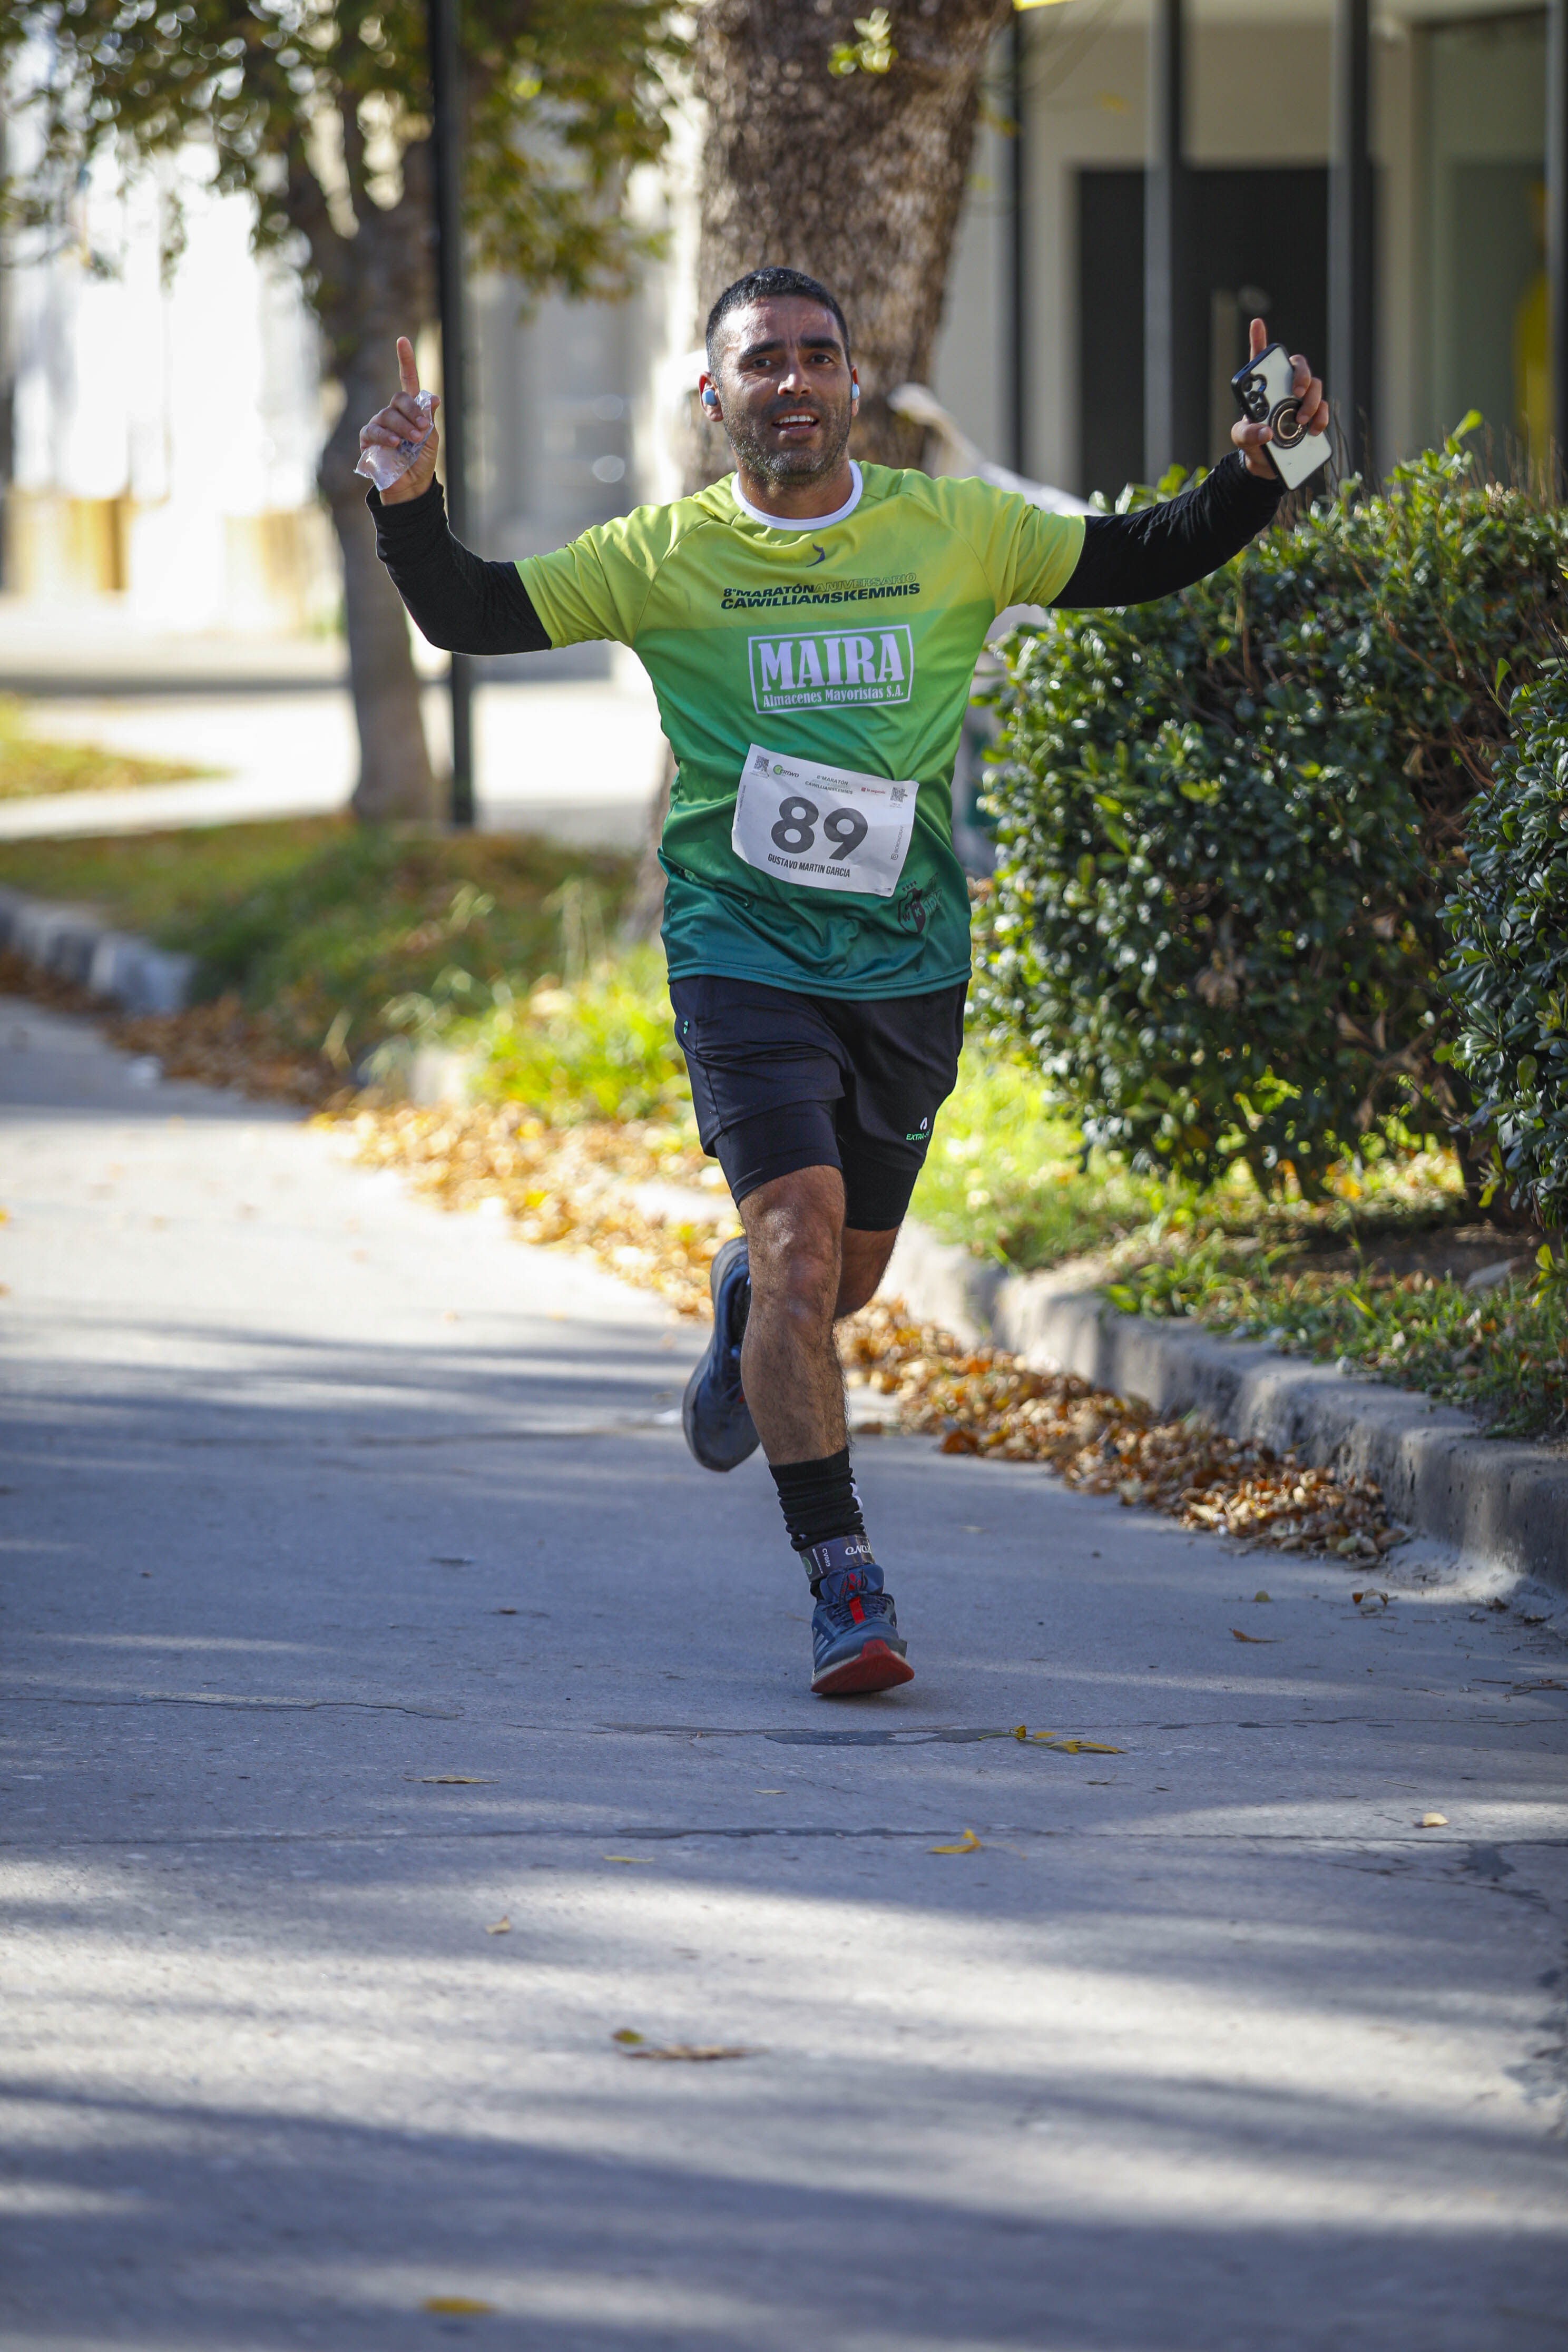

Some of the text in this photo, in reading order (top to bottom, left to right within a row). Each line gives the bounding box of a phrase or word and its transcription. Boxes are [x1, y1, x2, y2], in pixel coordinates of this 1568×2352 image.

[814, 572, 917, 593] ANIVERSARIO
[721, 583, 920, 610] CAWILLIAMSKEMMIS
[758, 633, 905, 692] MAIRA
[763, 684, 904, 708] Almacenes Mayoristas S.A.
[771, 796, 868, 861] 89
[768, 853, 850, 878] GUSTAVO MARTIN GARCIA
